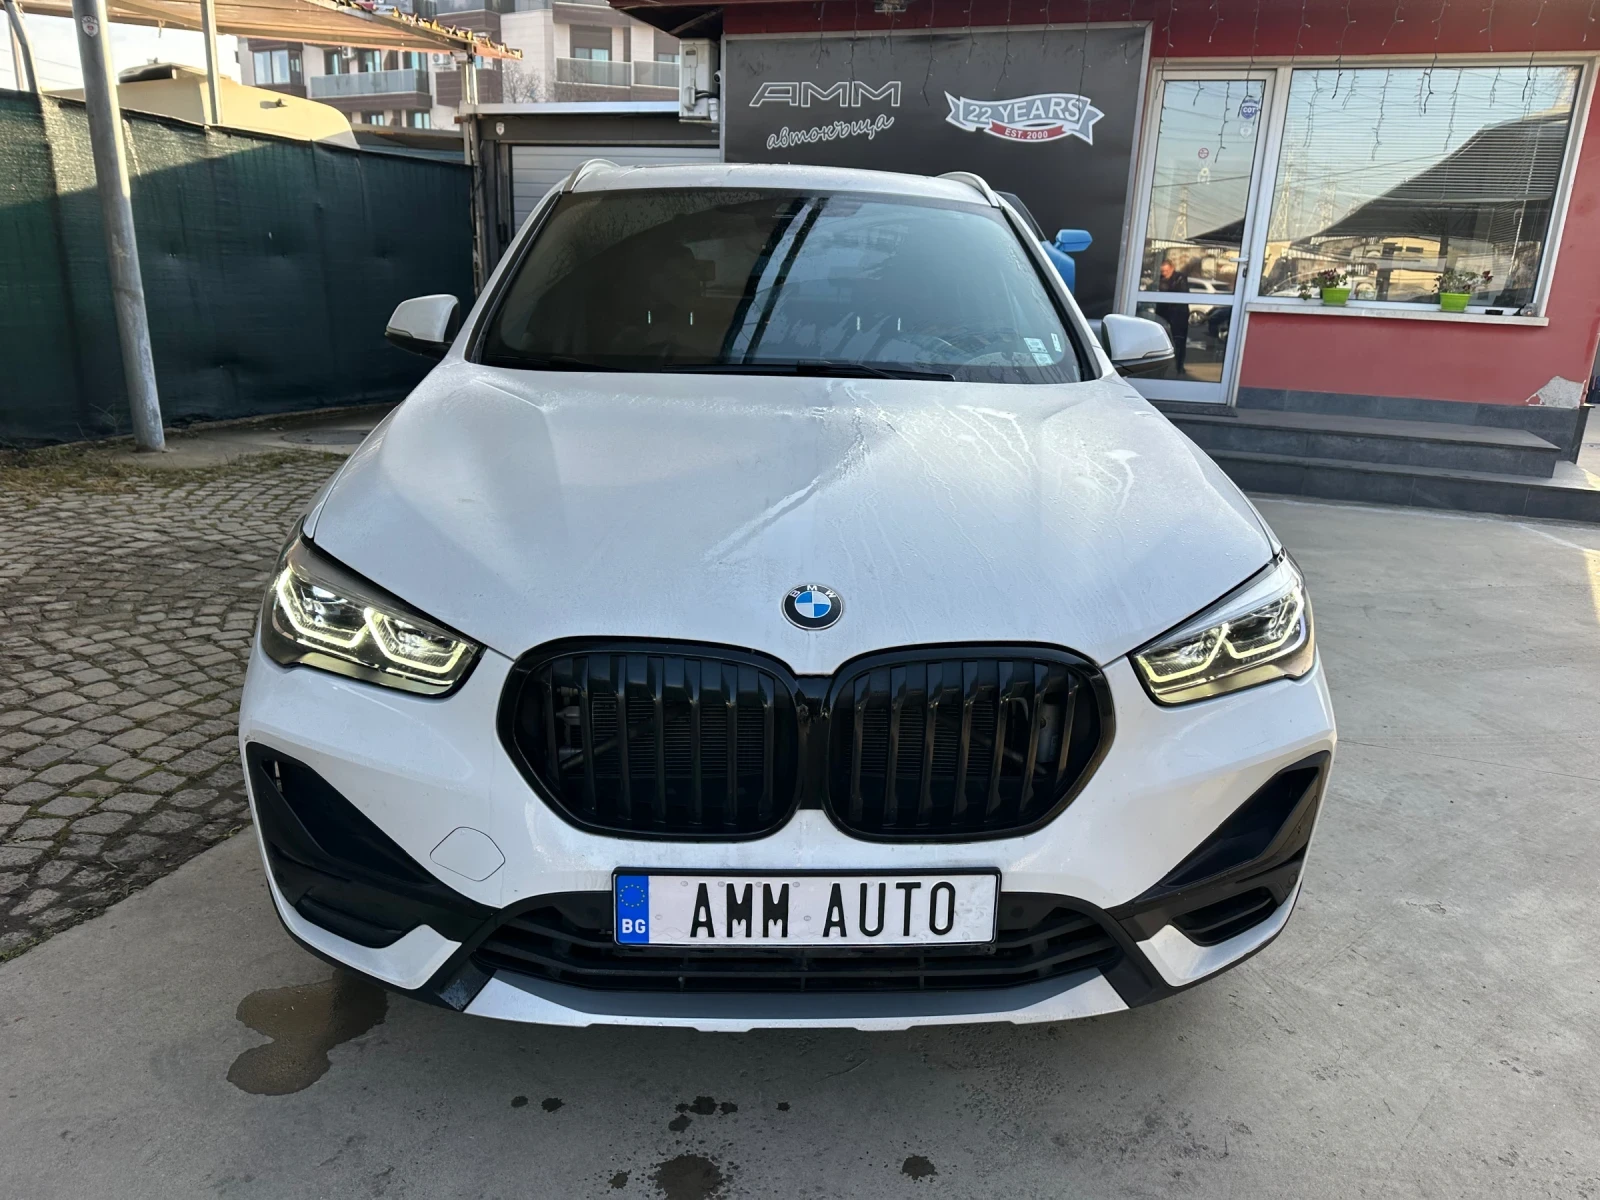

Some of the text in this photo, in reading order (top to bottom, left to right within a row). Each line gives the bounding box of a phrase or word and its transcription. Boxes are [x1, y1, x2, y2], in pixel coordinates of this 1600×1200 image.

[748, 80, 902, 108] AMM
[966, 97, 1083, 124] 22 YEARS
[766, 113, 895, 150] автокъща
[1004, 127, 1049, 140] EST. 2000
[788, 584, 837, 598] BMW
[689, 881, 956, 938] AMM AUTO
[621, 918, 646, 935] BG
